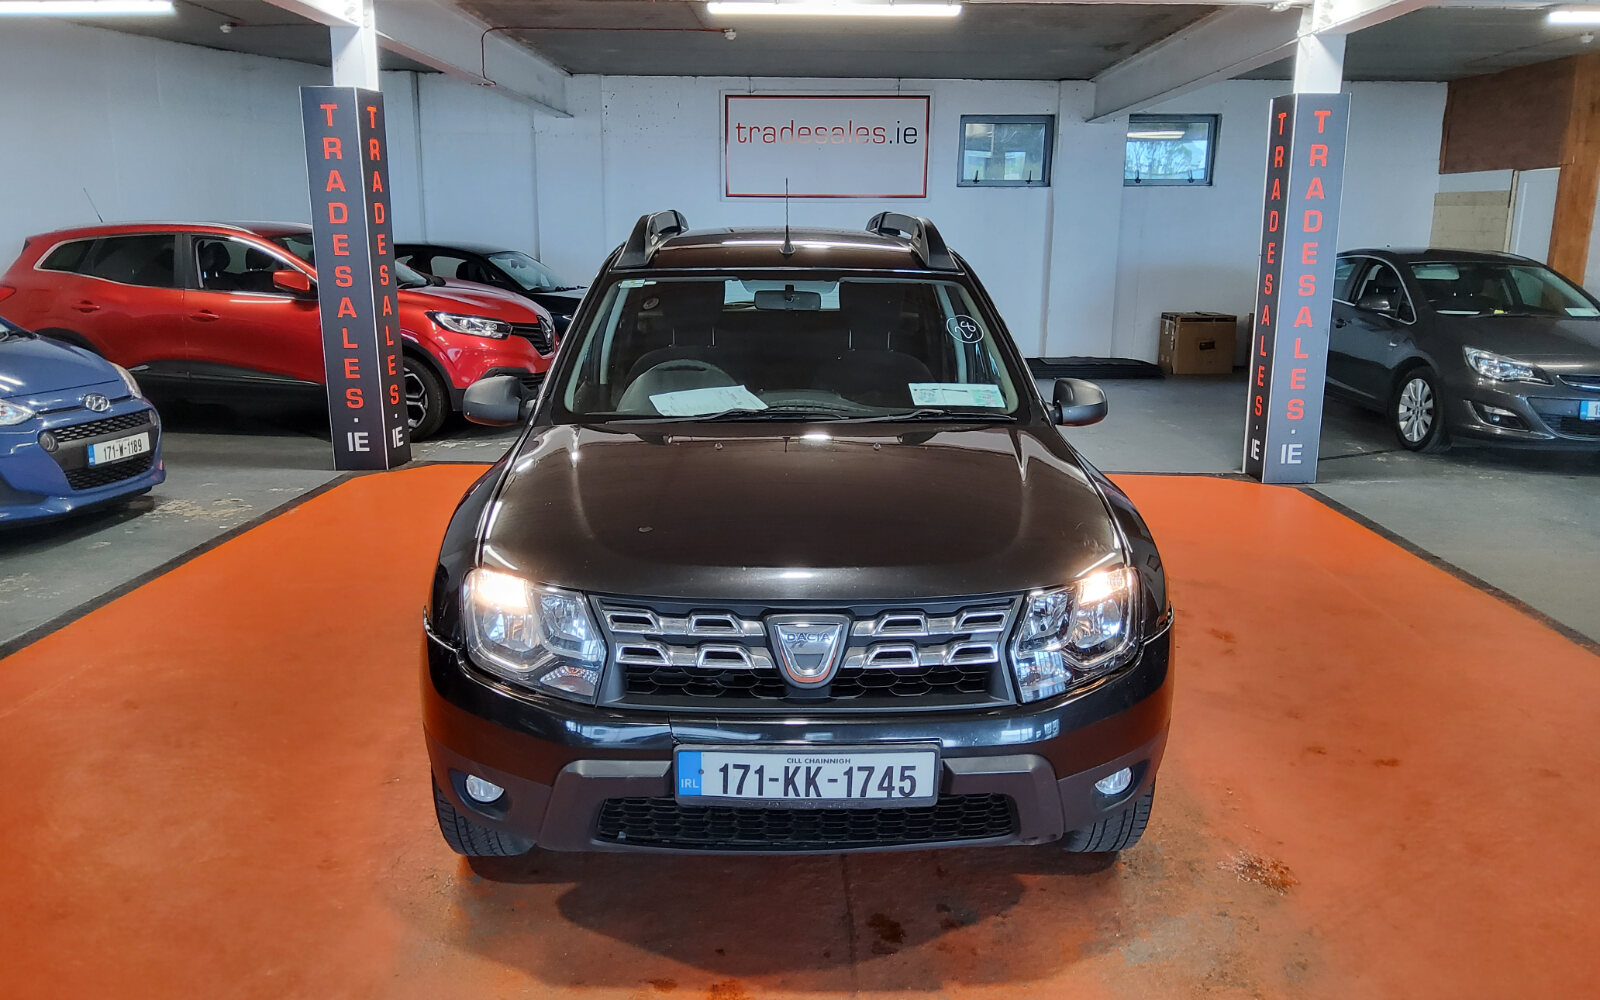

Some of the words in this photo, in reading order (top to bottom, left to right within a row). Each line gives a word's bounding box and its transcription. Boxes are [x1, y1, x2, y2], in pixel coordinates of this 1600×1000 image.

[735, 119, 918, 144] tradesales.ie
[103, 438, 143, 461] 171-W-1189
[786, 632, 831, 642] DACIA
[804, 757, 851, 765] CHAINNIGH
[680, 778, 699, 789] IRL
[718, 763, 917, 798] 171-KK-1745
